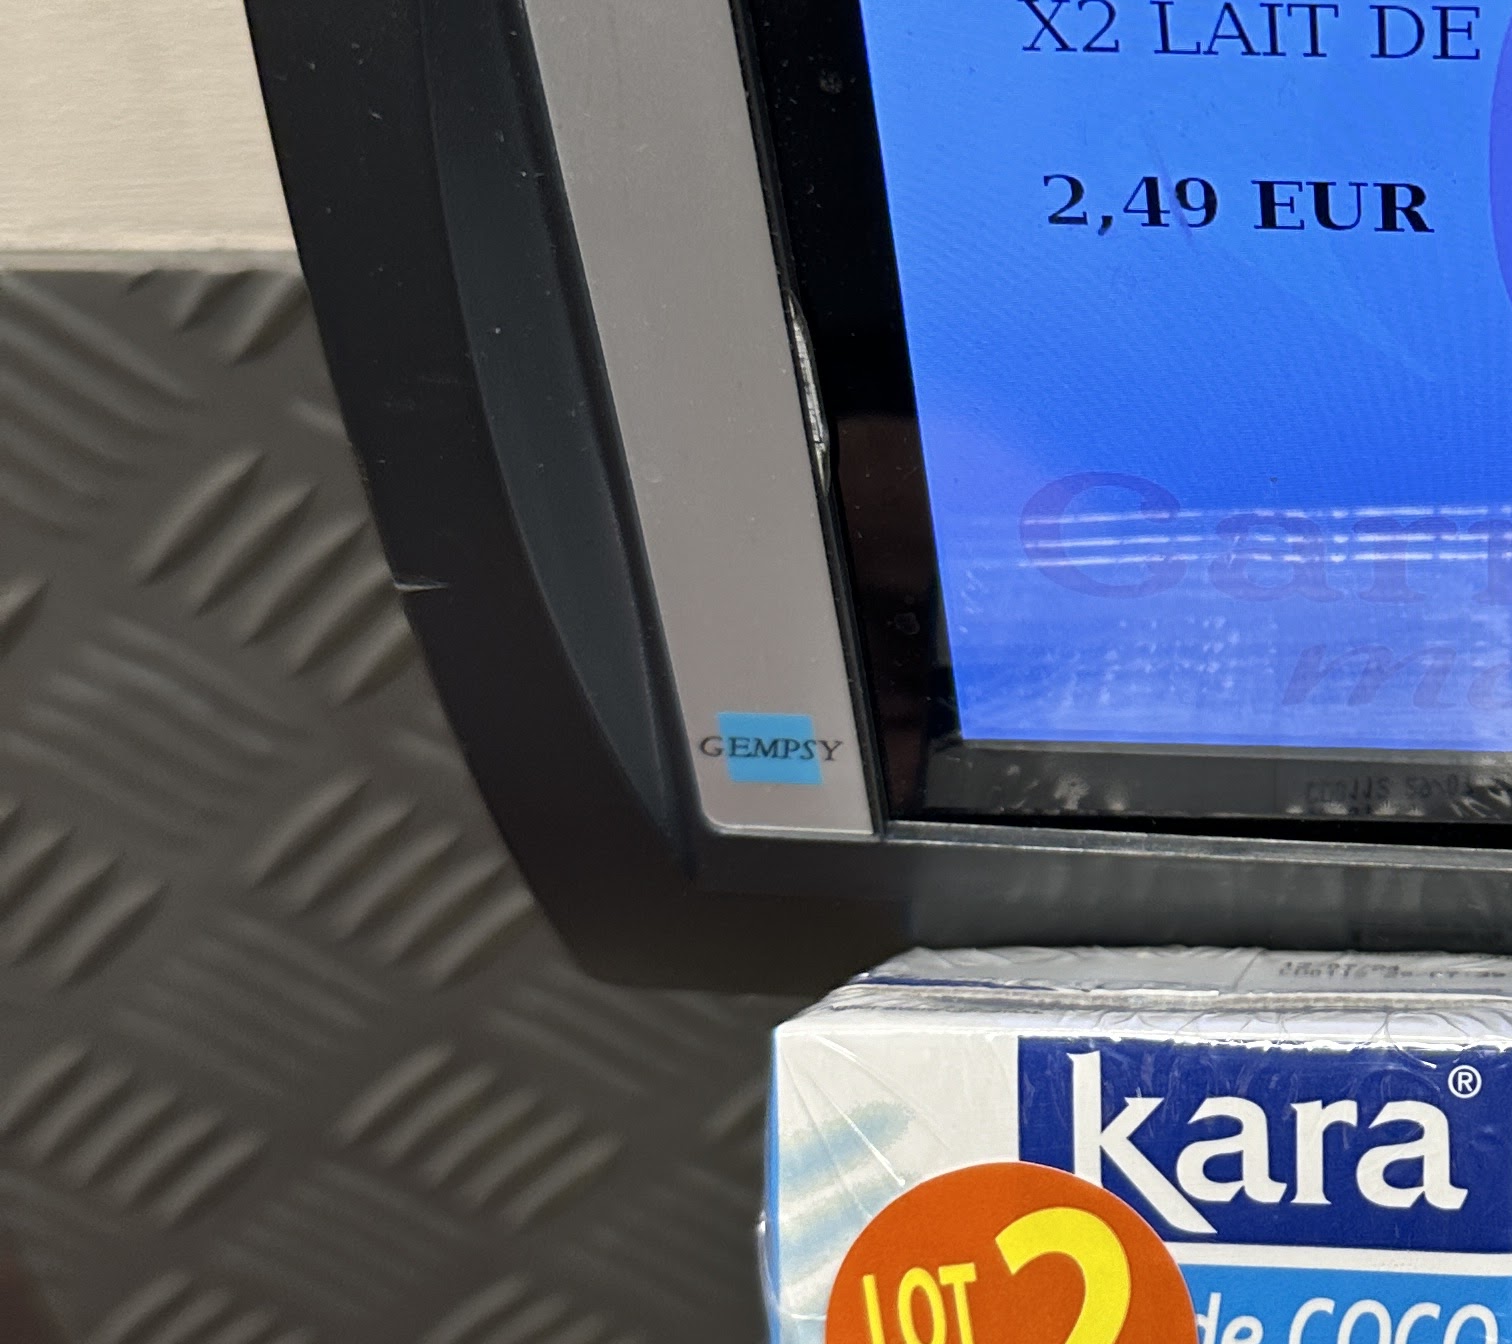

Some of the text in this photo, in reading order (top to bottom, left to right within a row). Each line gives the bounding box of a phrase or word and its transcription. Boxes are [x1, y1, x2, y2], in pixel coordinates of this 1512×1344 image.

[1150, 0, 1339, 57] LAIT
[1369, 4, 1480, 60] DE
[1043, 173, 1435, 236] 2,49 EUR
[699, 735, 844, 762] GEMPSY
[1066, 1049, 1470, 1235] kara
